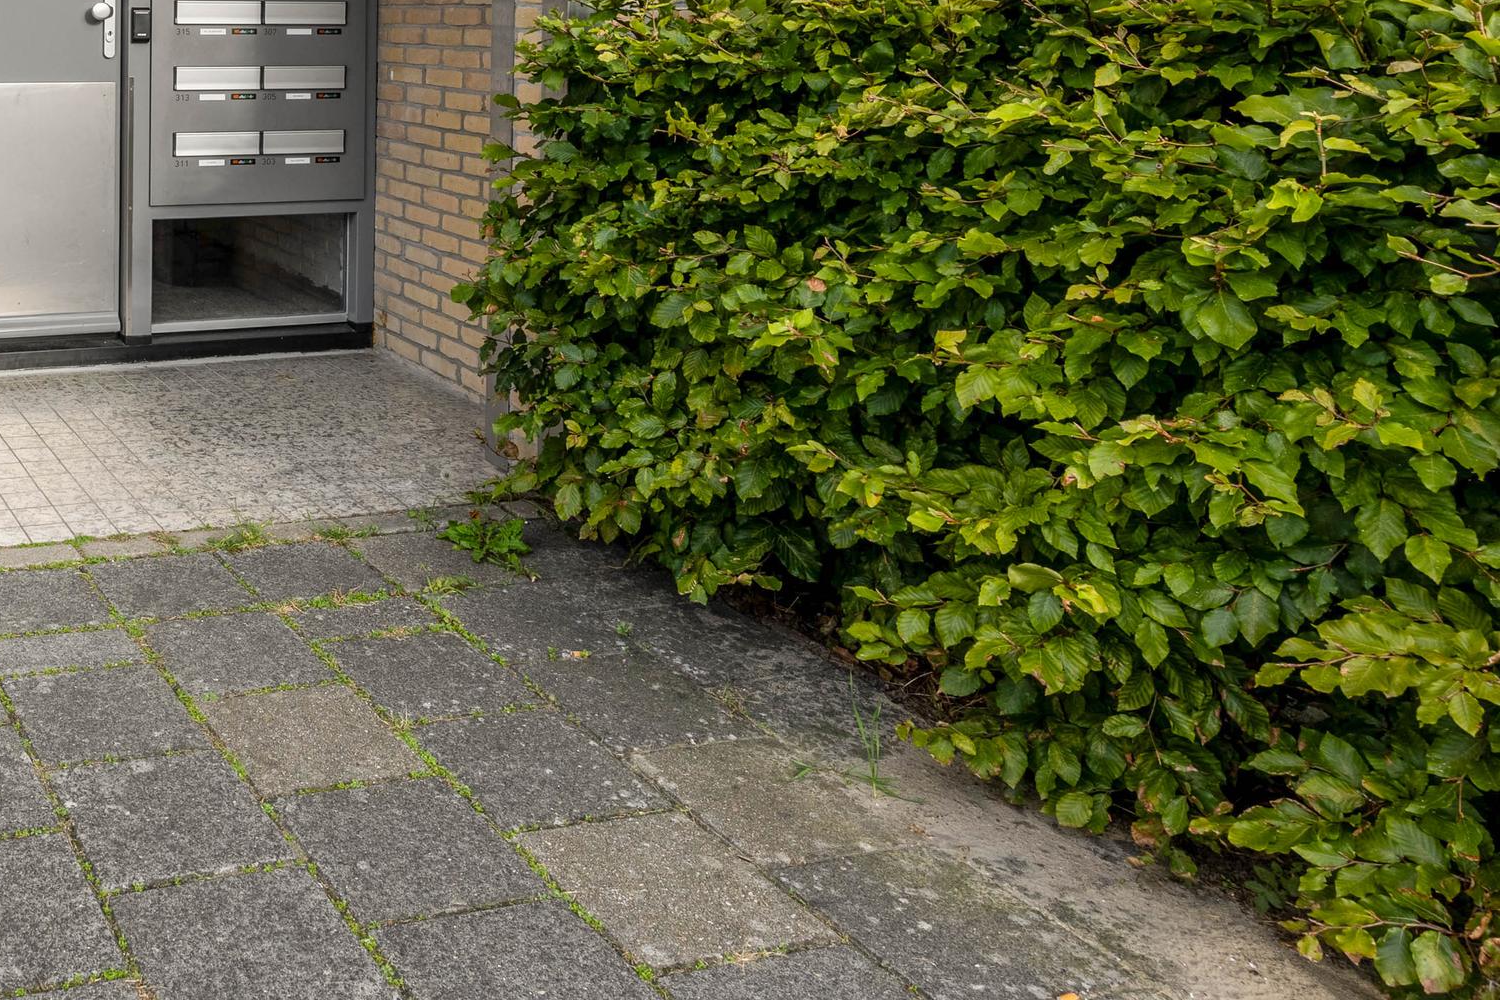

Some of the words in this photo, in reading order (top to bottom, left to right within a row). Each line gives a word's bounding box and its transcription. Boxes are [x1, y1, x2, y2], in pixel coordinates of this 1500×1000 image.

[175, 27, 190, 36] 315
[263, 27, 277, 36] 307
[175, 93, 190, 102] 313
[262, 92, 277, 101] 305
[174, 159, 189, 168] 311
[262, 157, 276, 166] 303
